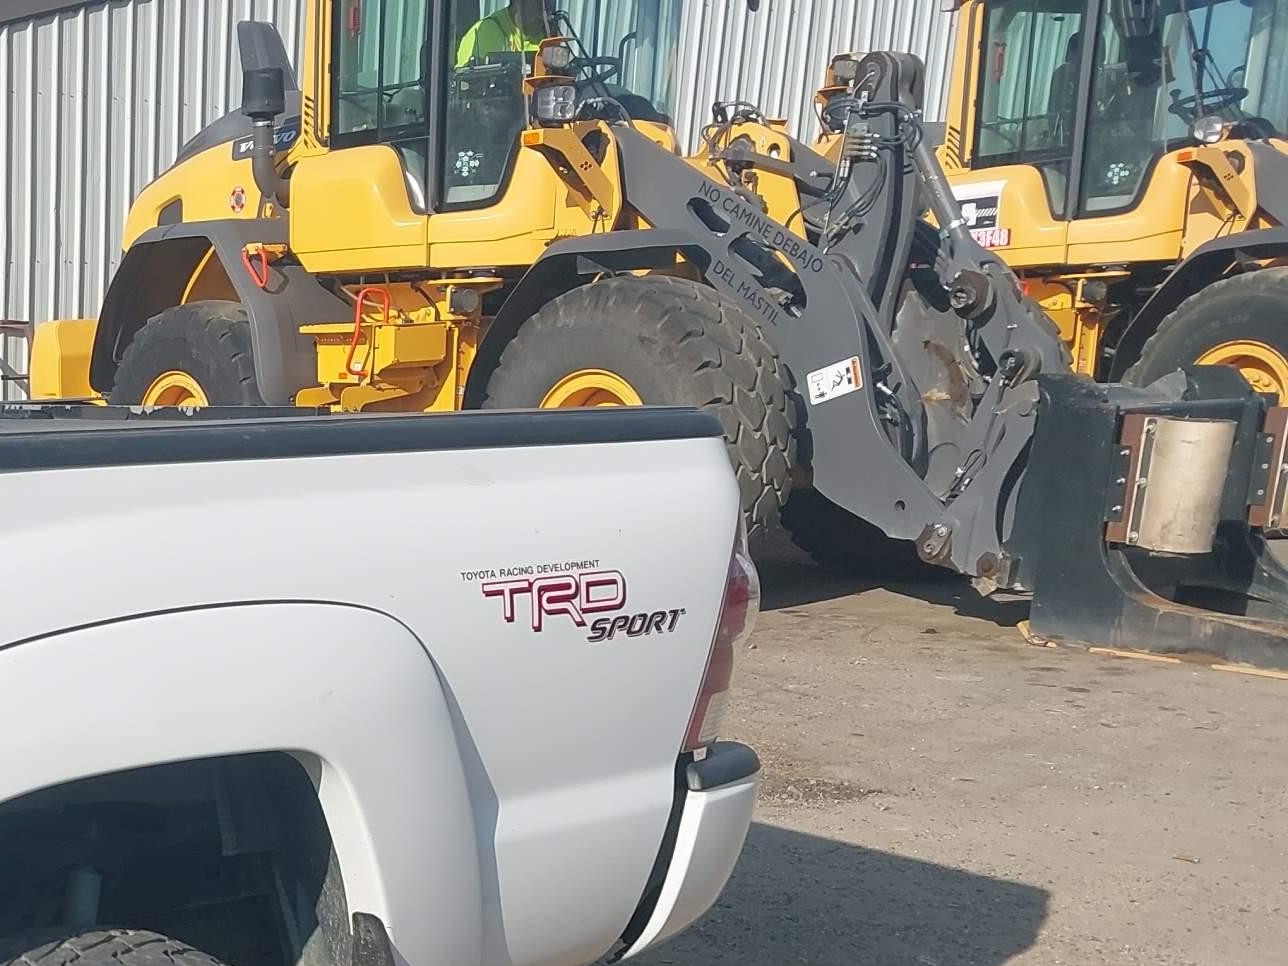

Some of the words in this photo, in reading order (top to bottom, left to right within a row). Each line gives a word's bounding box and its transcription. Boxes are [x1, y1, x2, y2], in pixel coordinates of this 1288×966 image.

[698, 180, 721, 203] NO
[722, 198, 772, 240] CAMINE
[772, 231, 823, 273] DEBAJO
[712, 259, 735, 288] DEL
[736, 281, 781, 327] MÁSTIL
[461, 569, 497, 582] TOYOTA
[499, 565, 534, 578] RACING
[536, 559, 601, 574] DEVELOPMENT
[481, 569, 627, 633] TRD
[586, 608, 685, 643] SPORT
